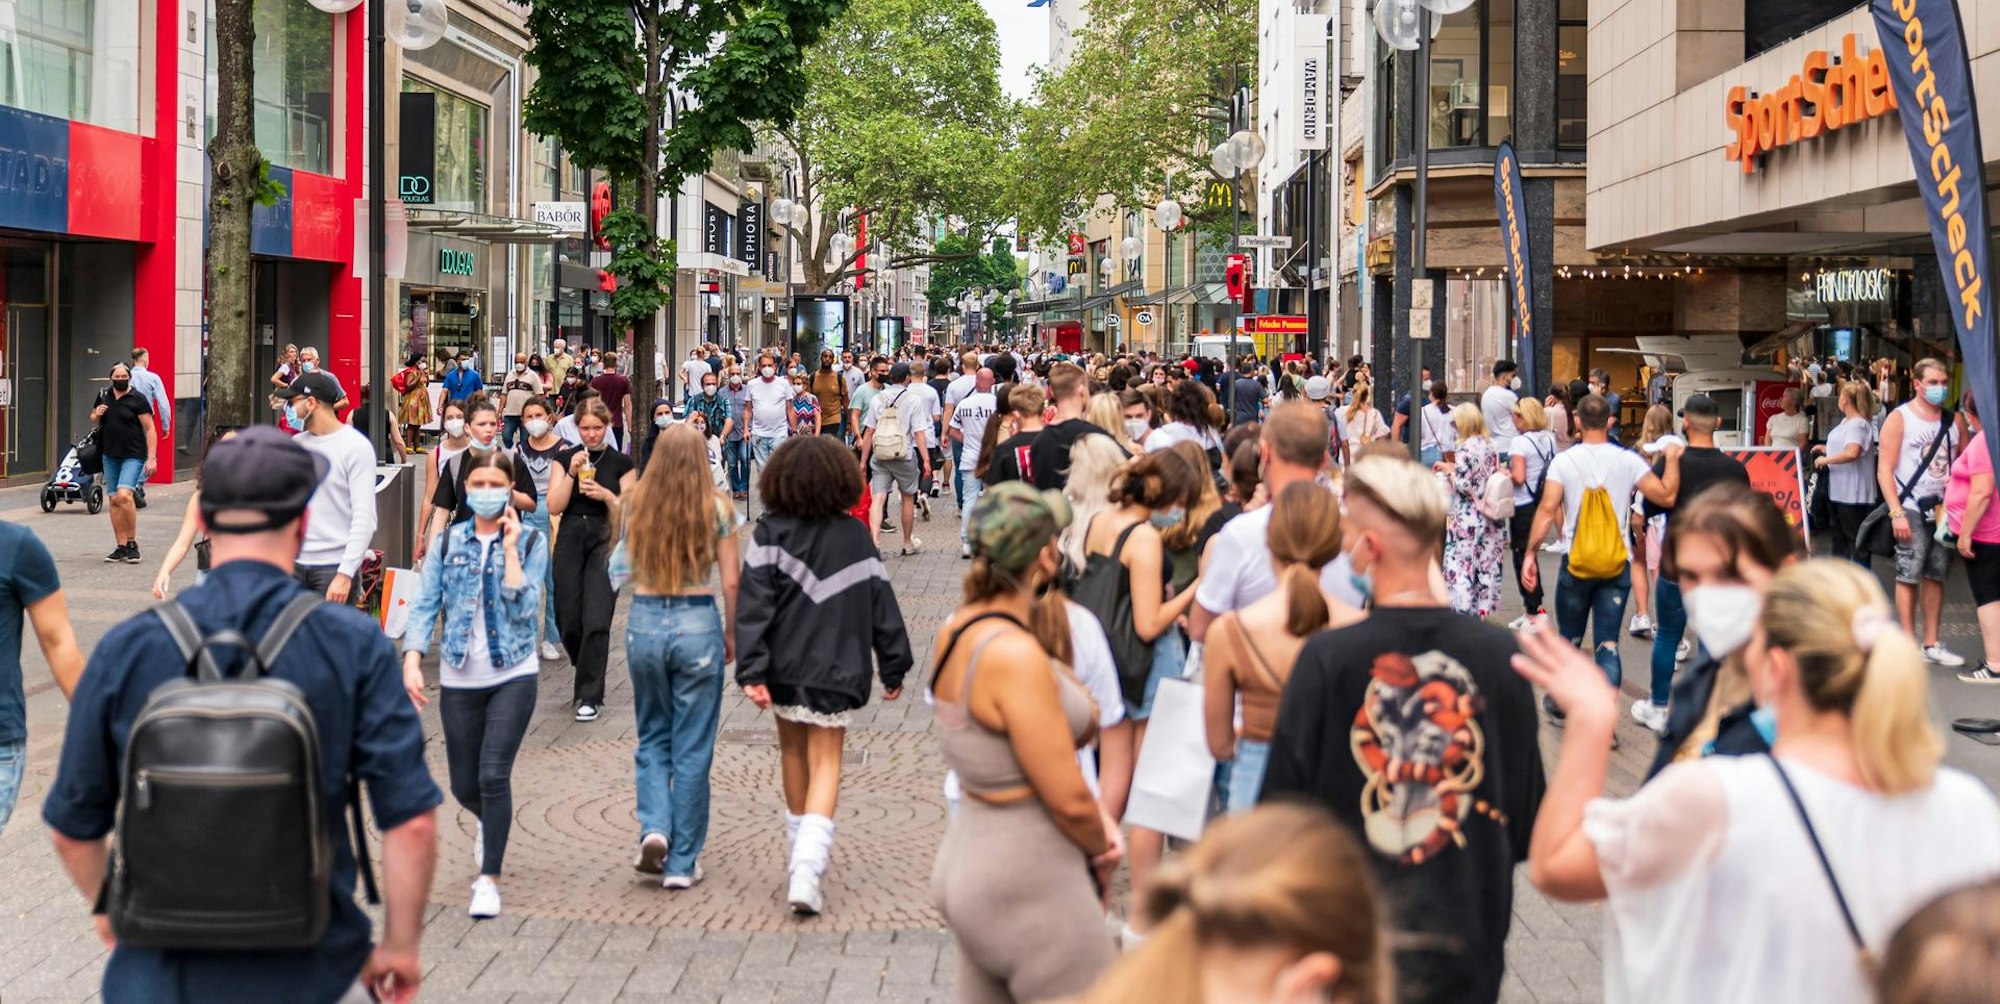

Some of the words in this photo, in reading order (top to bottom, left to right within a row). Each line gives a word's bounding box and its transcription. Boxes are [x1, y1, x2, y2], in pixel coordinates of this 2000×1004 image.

[1304, 96, 1316, 139] DENIM
[1727, 33, 1896, 173] SportSche
[400, 195, 430, 203] DOUGLAS
[537, 210, 582, 223] BABOR
[746, 205, 756, 268] SEPHORA
[1502, 156, 1530, 338] SportScheck
[441, 249, 474, 275] DOUGLAS
[1259, 320, 1281, 329] Frische
